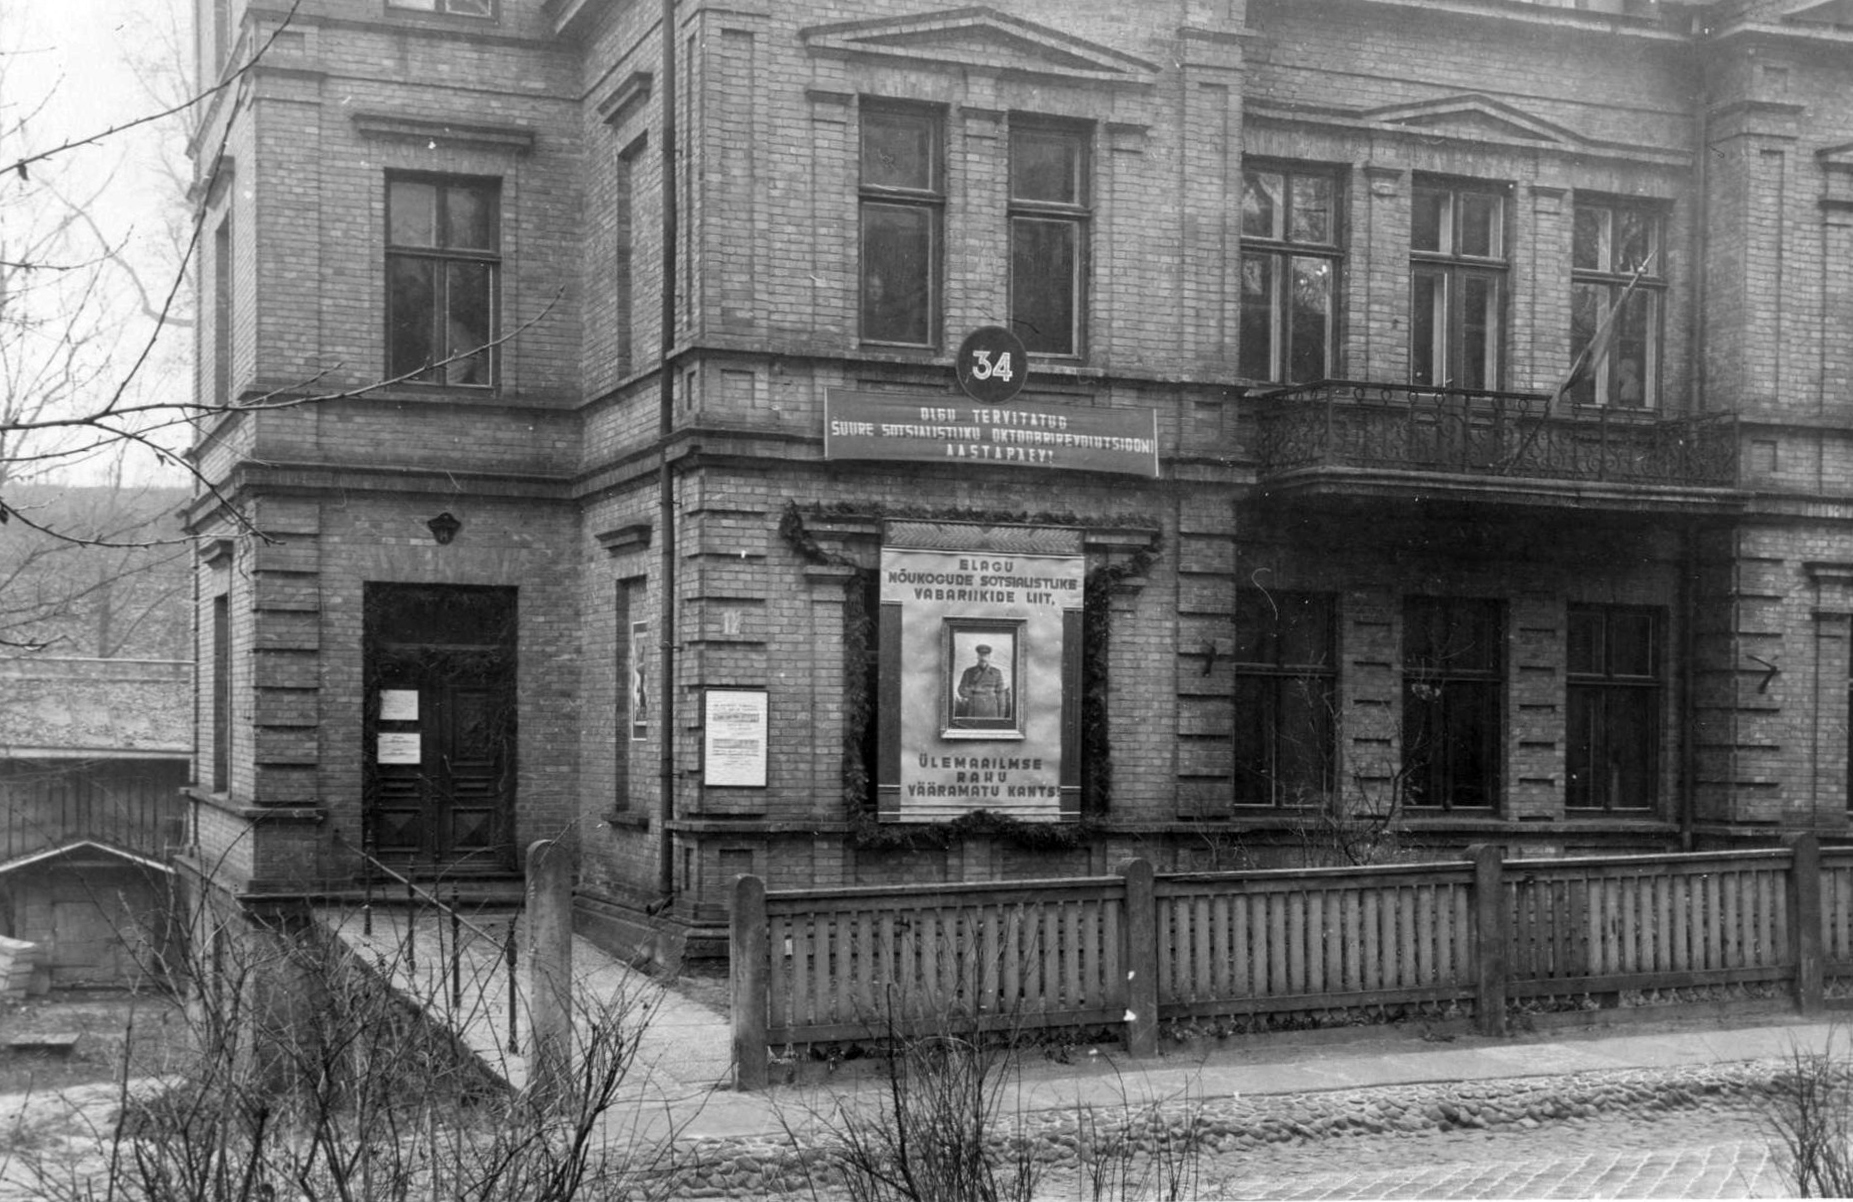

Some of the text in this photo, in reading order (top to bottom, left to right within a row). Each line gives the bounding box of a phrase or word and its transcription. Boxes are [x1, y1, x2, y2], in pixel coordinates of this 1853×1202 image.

[972, 350, 1013, 382] 34
[831, 420, 874, 436] SUURE
[959, 559, 1013, 572] ELAGU
[888, 568, 974, 586] NÕUKOGUDE
[914, 588, 1015, 603] VABARIIKIDE
[919, 752, 1042, 770] ÜLEMAAILMSE
[957, 771, 1007, 783] RAHU
[908, 781, 1061, 798] VÄÄRAMATU KANTS!
